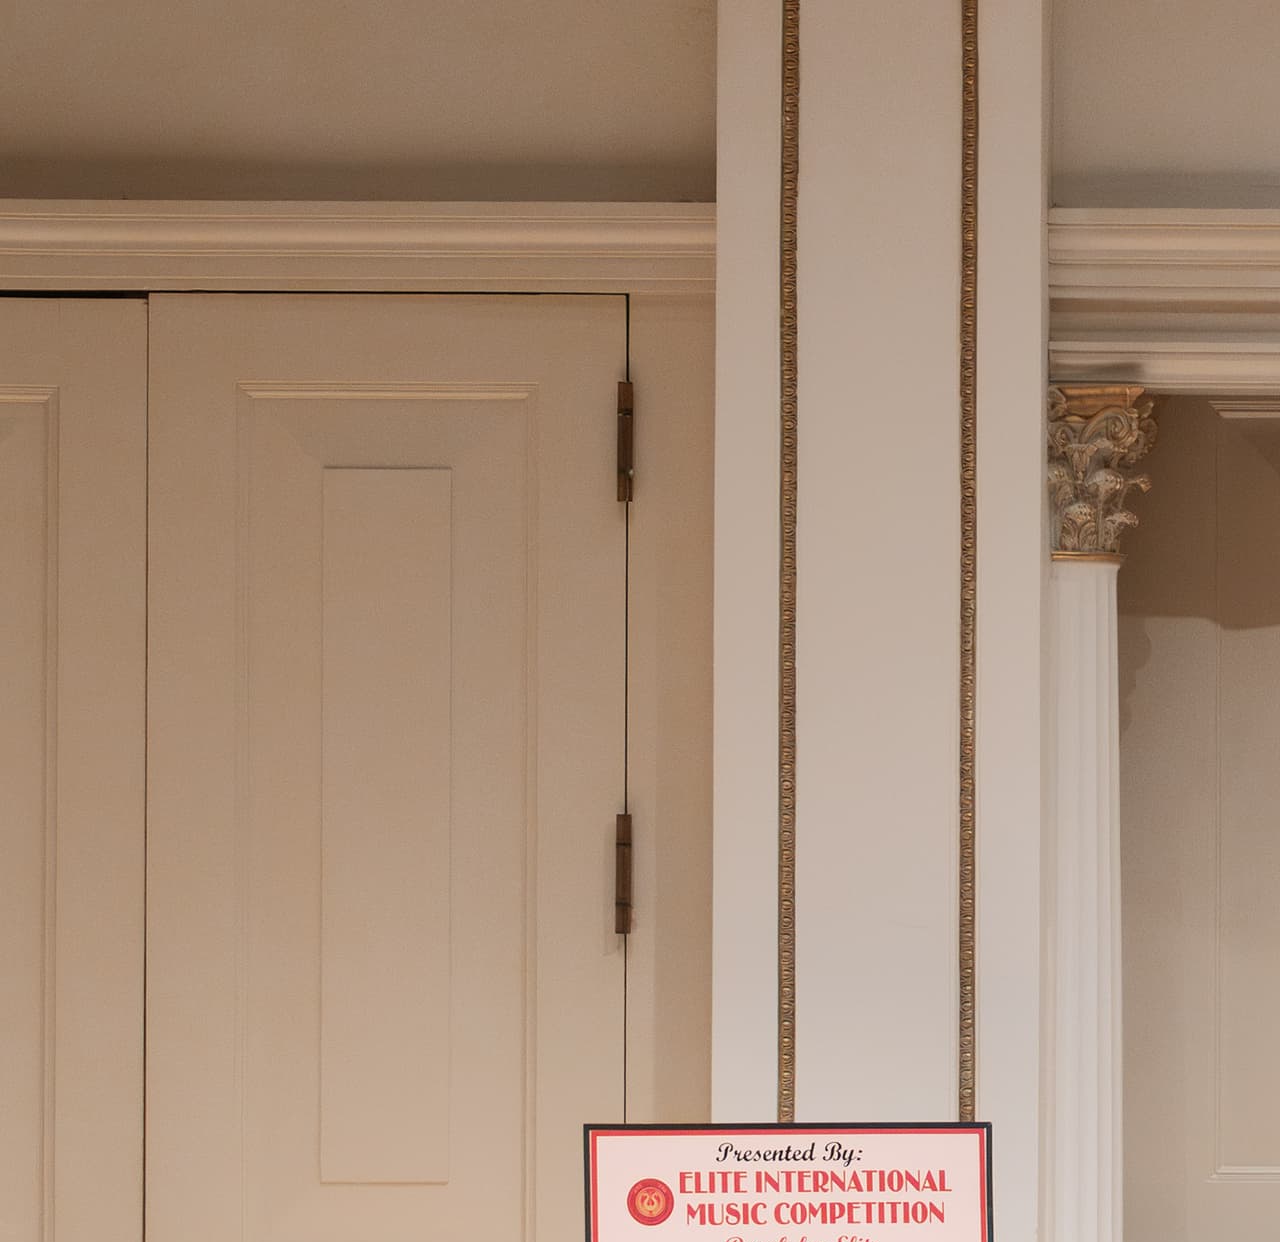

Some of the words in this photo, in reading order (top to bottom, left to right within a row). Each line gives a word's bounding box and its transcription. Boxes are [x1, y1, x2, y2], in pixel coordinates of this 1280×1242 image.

[716, 1142, 816, 1163] Presented
[822, 1141, 864, 1168] By:
[679, 1171, 748, 1194] ELITE
[755, 1169, 953, 1194] INTERNATIONAL
[686, 1202, 768, 1226] MUSIC
[773, 1201, 946, 1225] COMPETITION
